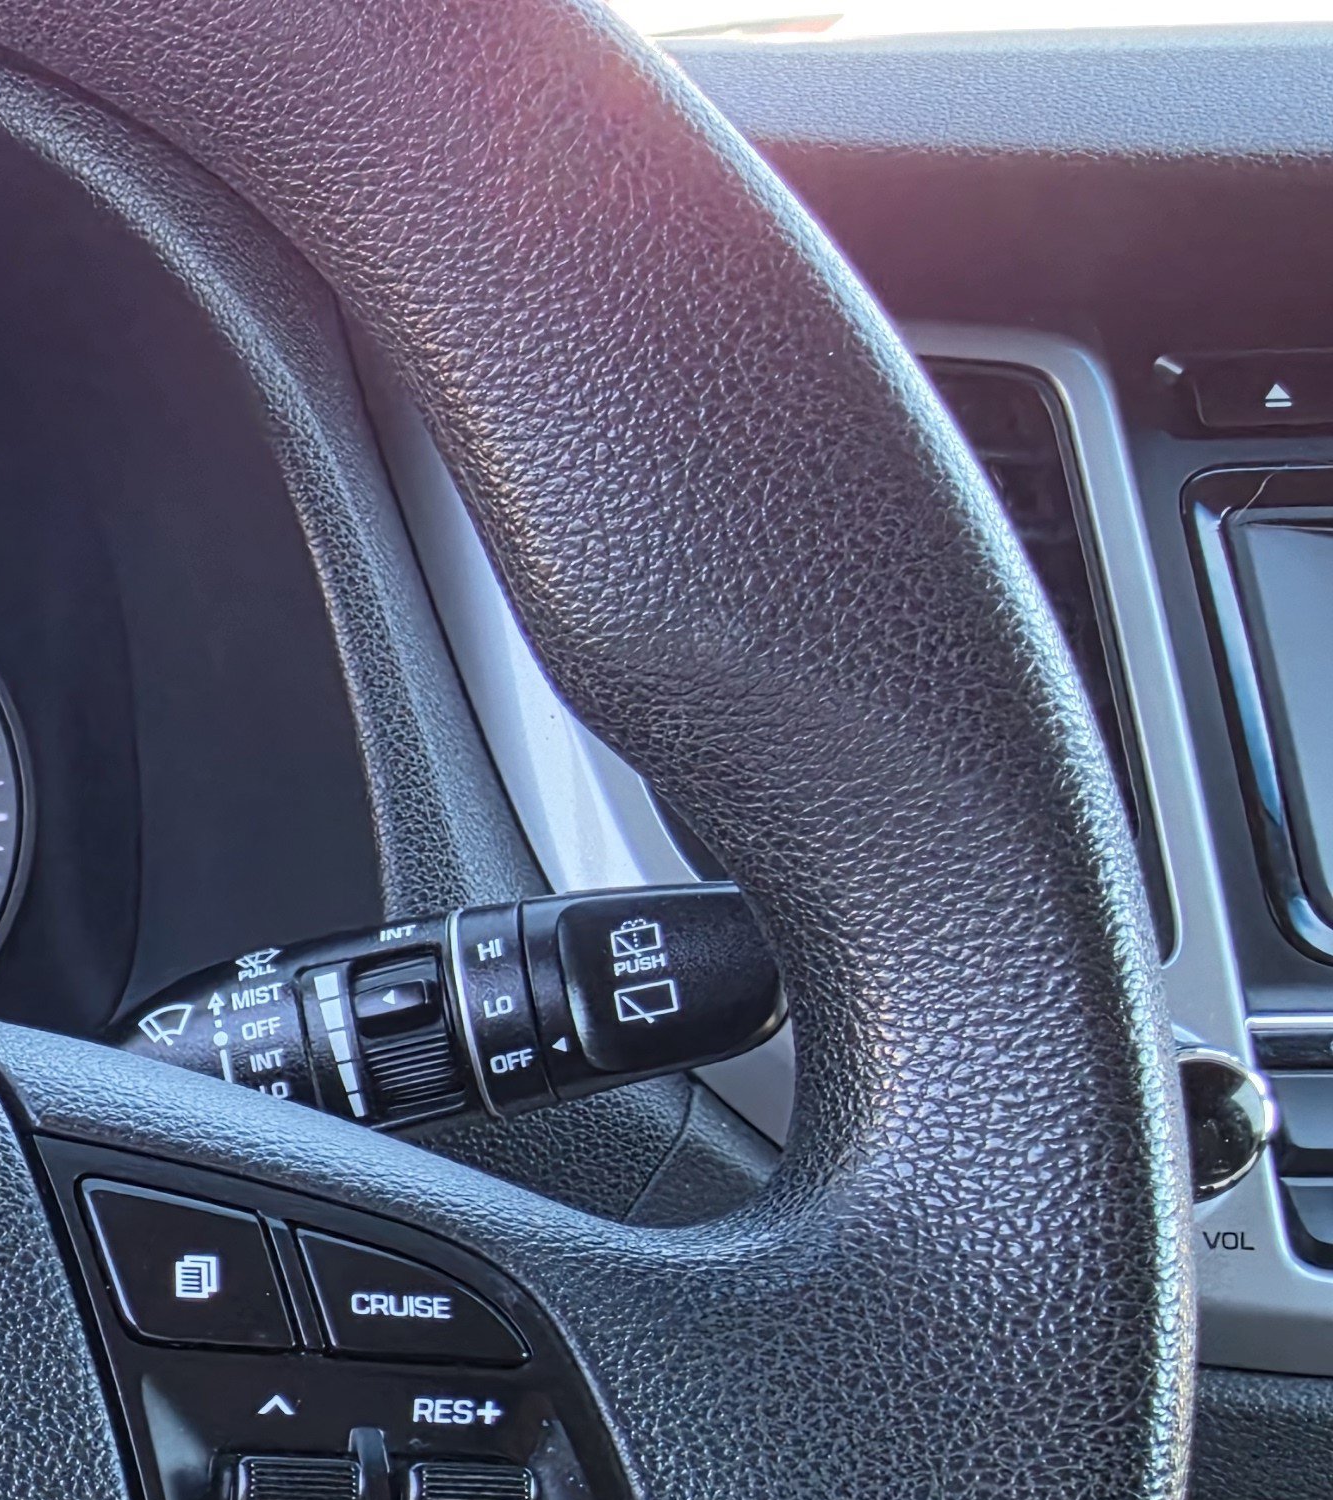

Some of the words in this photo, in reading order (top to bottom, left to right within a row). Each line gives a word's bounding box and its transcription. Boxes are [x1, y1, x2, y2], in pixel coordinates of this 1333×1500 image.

[380, 925, 416, 941] INT
[477, 938, 503, 961] HI
[238, 964, 276, 981] PULL
[614, 953, 667, 976] PUSH
[231, 982, 282, 1011] MIST
[483, 995, 513, 1018] LO
[241, 1017, 281, 1041] OFF
[250, 1049, 282, 1073] INT
[490, 1049, 533, 1074] OFF
[1202, 1231, 1255, 1251] VOL
[351, 1293, 451, 1319] CRUISE
[413, 1399, 501, 1424] RES+
